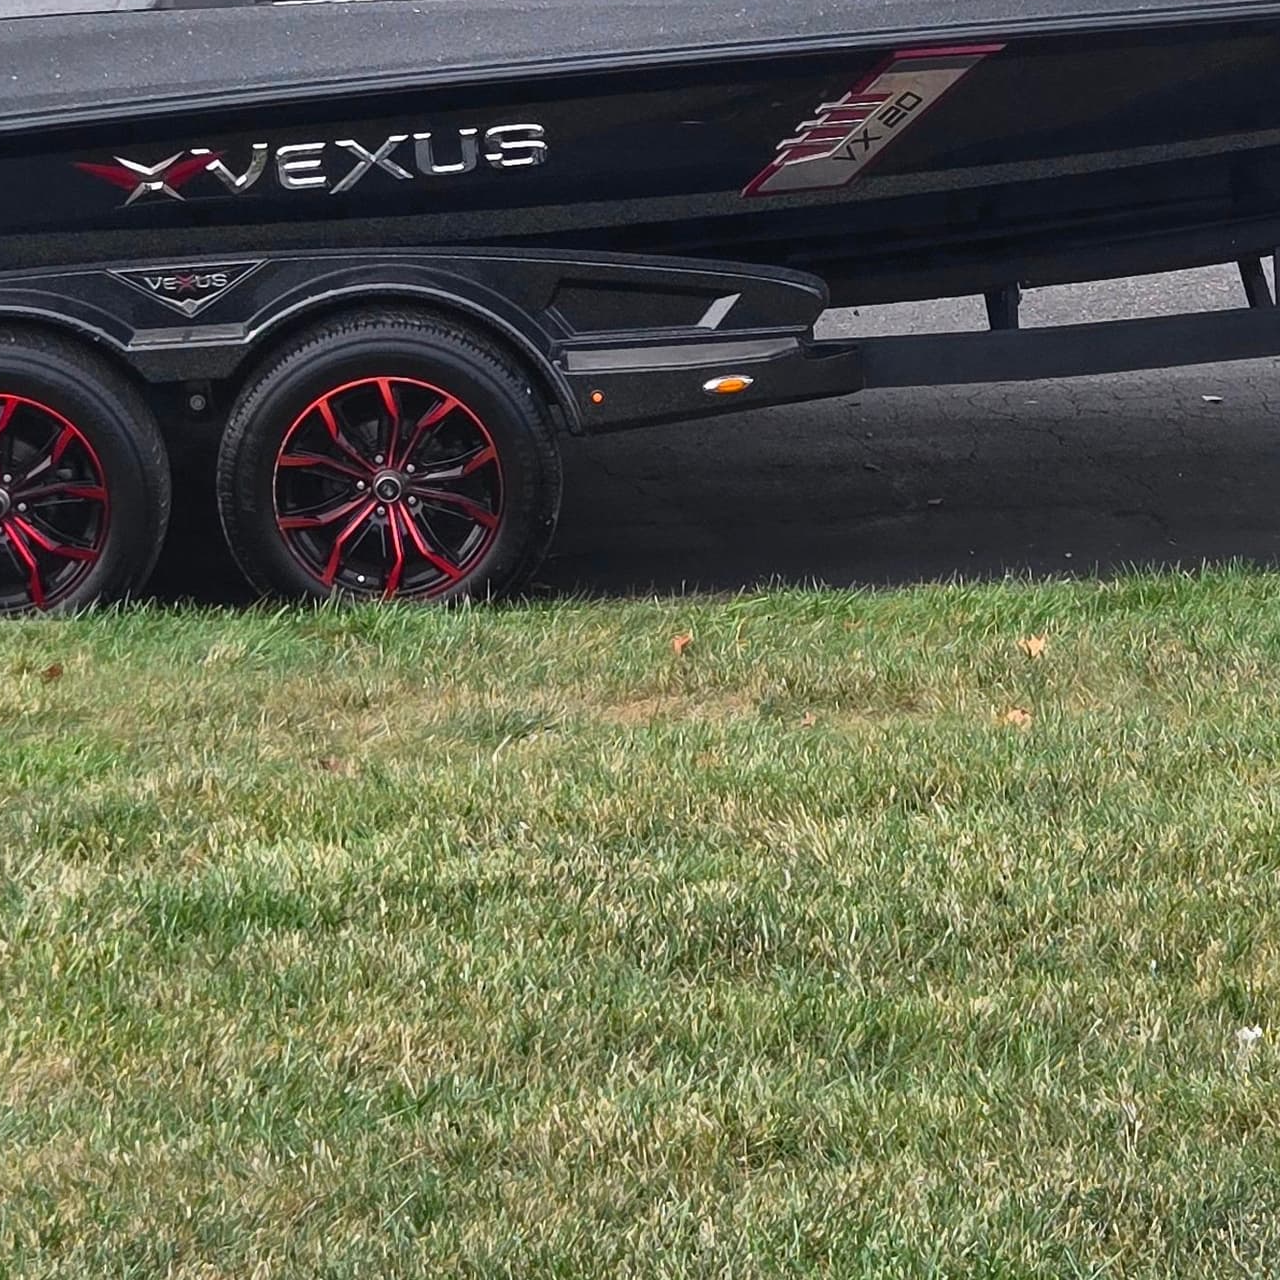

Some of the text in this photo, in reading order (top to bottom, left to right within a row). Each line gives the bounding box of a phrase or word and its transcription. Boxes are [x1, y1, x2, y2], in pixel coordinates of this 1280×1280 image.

[189, 121, 549, 195] VEXUS
[832, 90, 923, 161] VX 20
[144, 272, 228, 293] VEXUS
